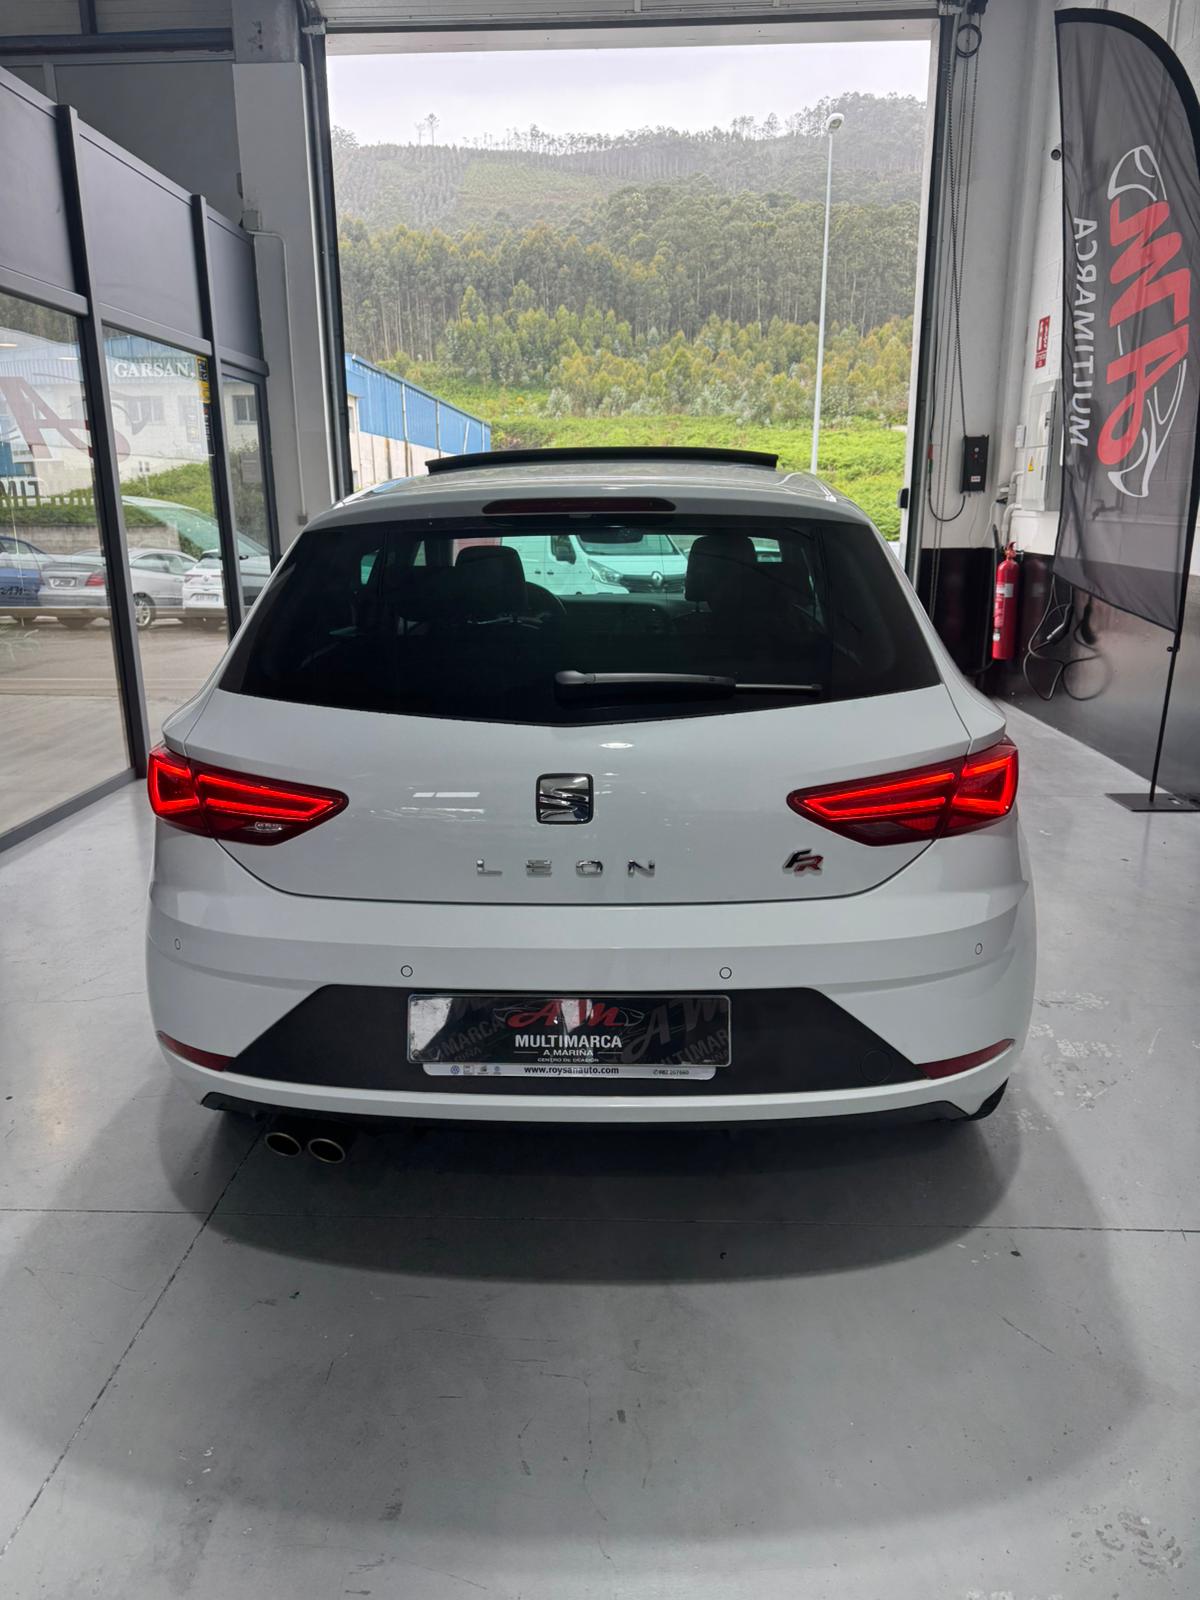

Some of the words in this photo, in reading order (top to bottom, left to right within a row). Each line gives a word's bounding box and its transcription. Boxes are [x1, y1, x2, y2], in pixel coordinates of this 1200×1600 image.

[476, 859, 656, 877] LEON
[783, 848, 824, 876] FR
[515, 1034, 623, 1048] MULTIMARCA
[524, 1065, 620, 1076] www.roysanauto.com
